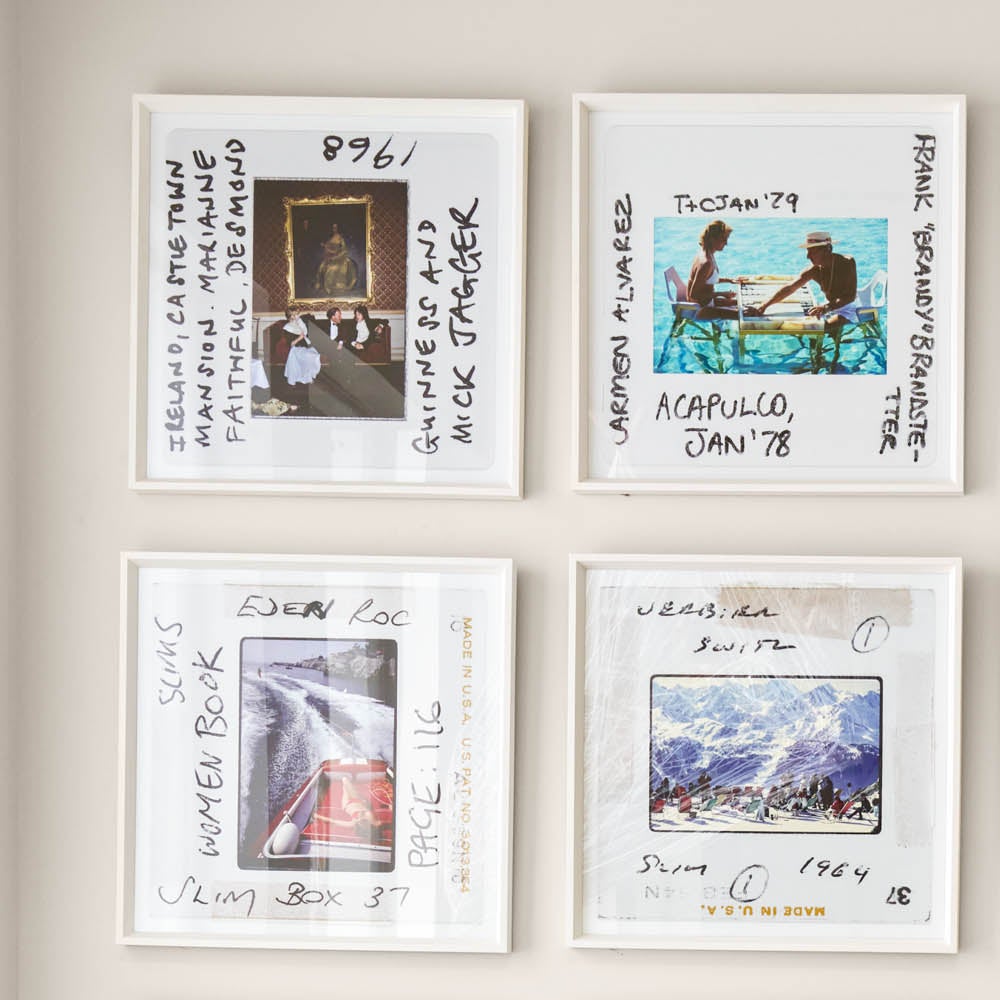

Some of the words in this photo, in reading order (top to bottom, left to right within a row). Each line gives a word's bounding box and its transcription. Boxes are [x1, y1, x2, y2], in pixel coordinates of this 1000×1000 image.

[323, 134, 417, 169] 1968
[913, 134, 936, 212] FRANK
[226, 139, 248, 276] DESMOND
[416, 220, 443, 285] AND
[448, 197, 483, 346] JAGGER
[613, 193, 634, 322] ALVAREZ
[411, 297, 441, 454] GUINNESS
[451, 365, 476, 444] MICK
[348, 598, 412, 628] ROC
[460, 616, 474, 659] MADE
[192, 646, 228, 738] BOOK
[460, 665, 474, 679] IN
[196, 753, 224, 857] WOMEN
[158, 876, 256, 917] SLIM
[275, 882, 344, 906] BOX
[364, 887, 410, 907] 37
[800, 856, 870, 884] 1964
[886, 887, 912, 905] 37
[760, 906, 777, 916] IN
[783, 906, 825, 916] MADE
